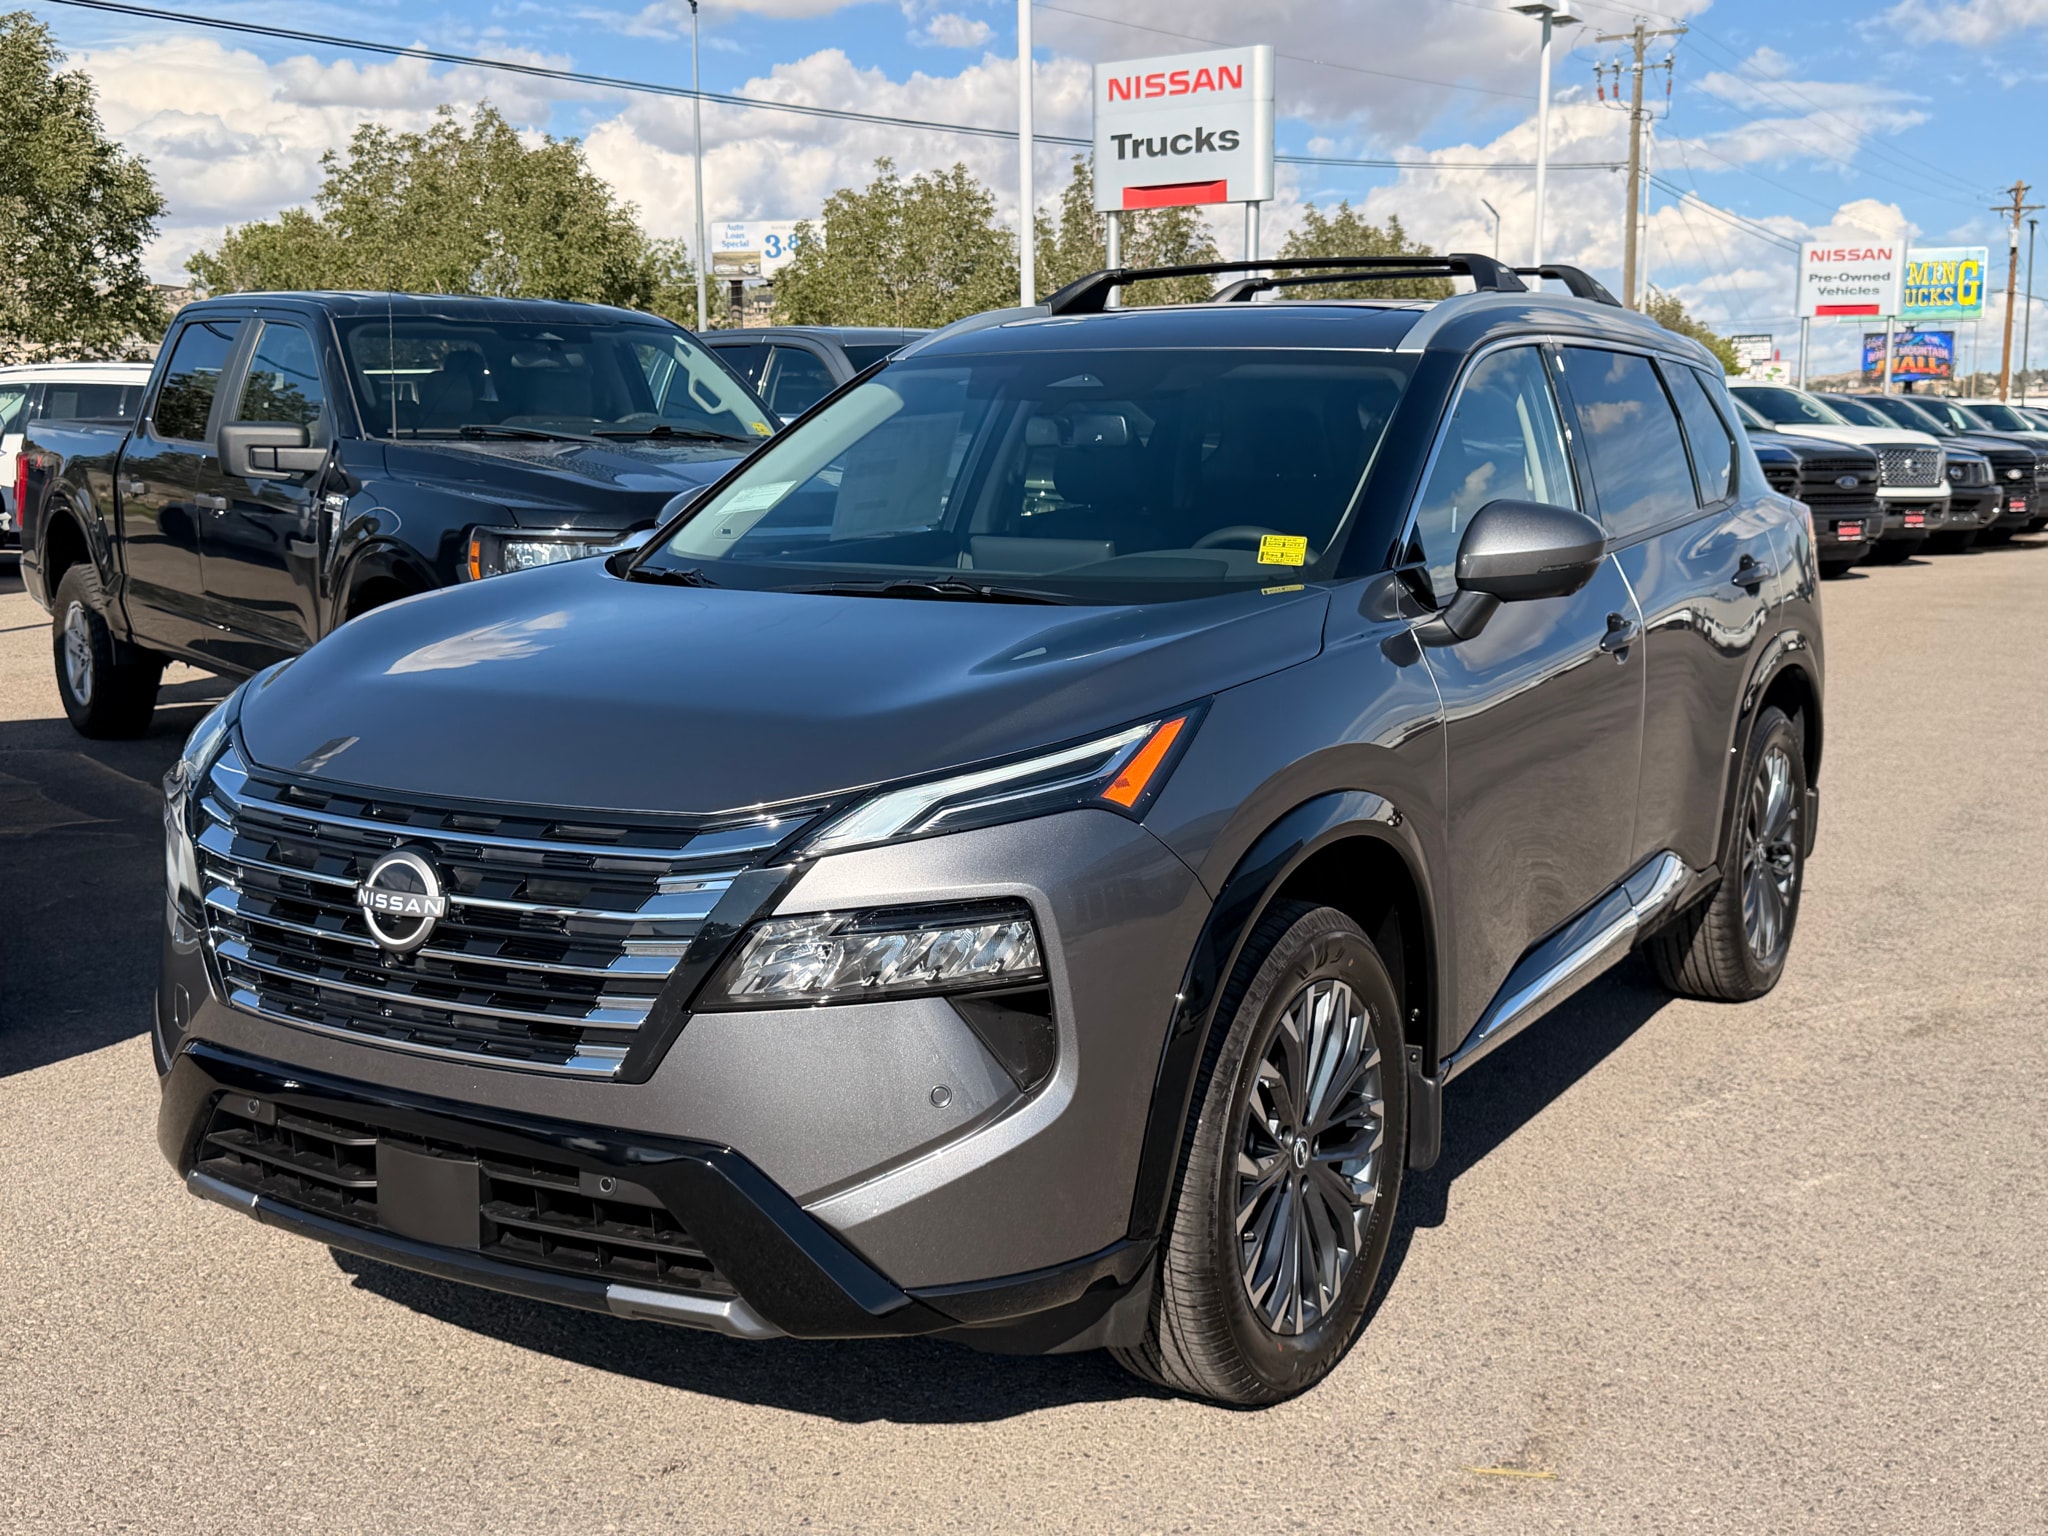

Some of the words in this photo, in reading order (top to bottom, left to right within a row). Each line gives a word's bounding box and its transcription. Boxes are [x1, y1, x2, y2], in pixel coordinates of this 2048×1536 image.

[1108, 64, 1243, 102] NISSAN
[1110, 126, 1240, 160] Trucks
[725, 231, 745, 240] Loan
[727, 223, 745, 232] Auto
[721, 240, 750, 250] Special
[764, 233, 803, 259] 3.8
[1809, 247, 1893, 263] NISSAN
[1808, 271, 1891, 283] Pre-Owned
[1817, 286, 1880, 296] Vehicles
[1904, 287, 1954, 307] UCKS
[358, 887, 442, 915] NISSAN
